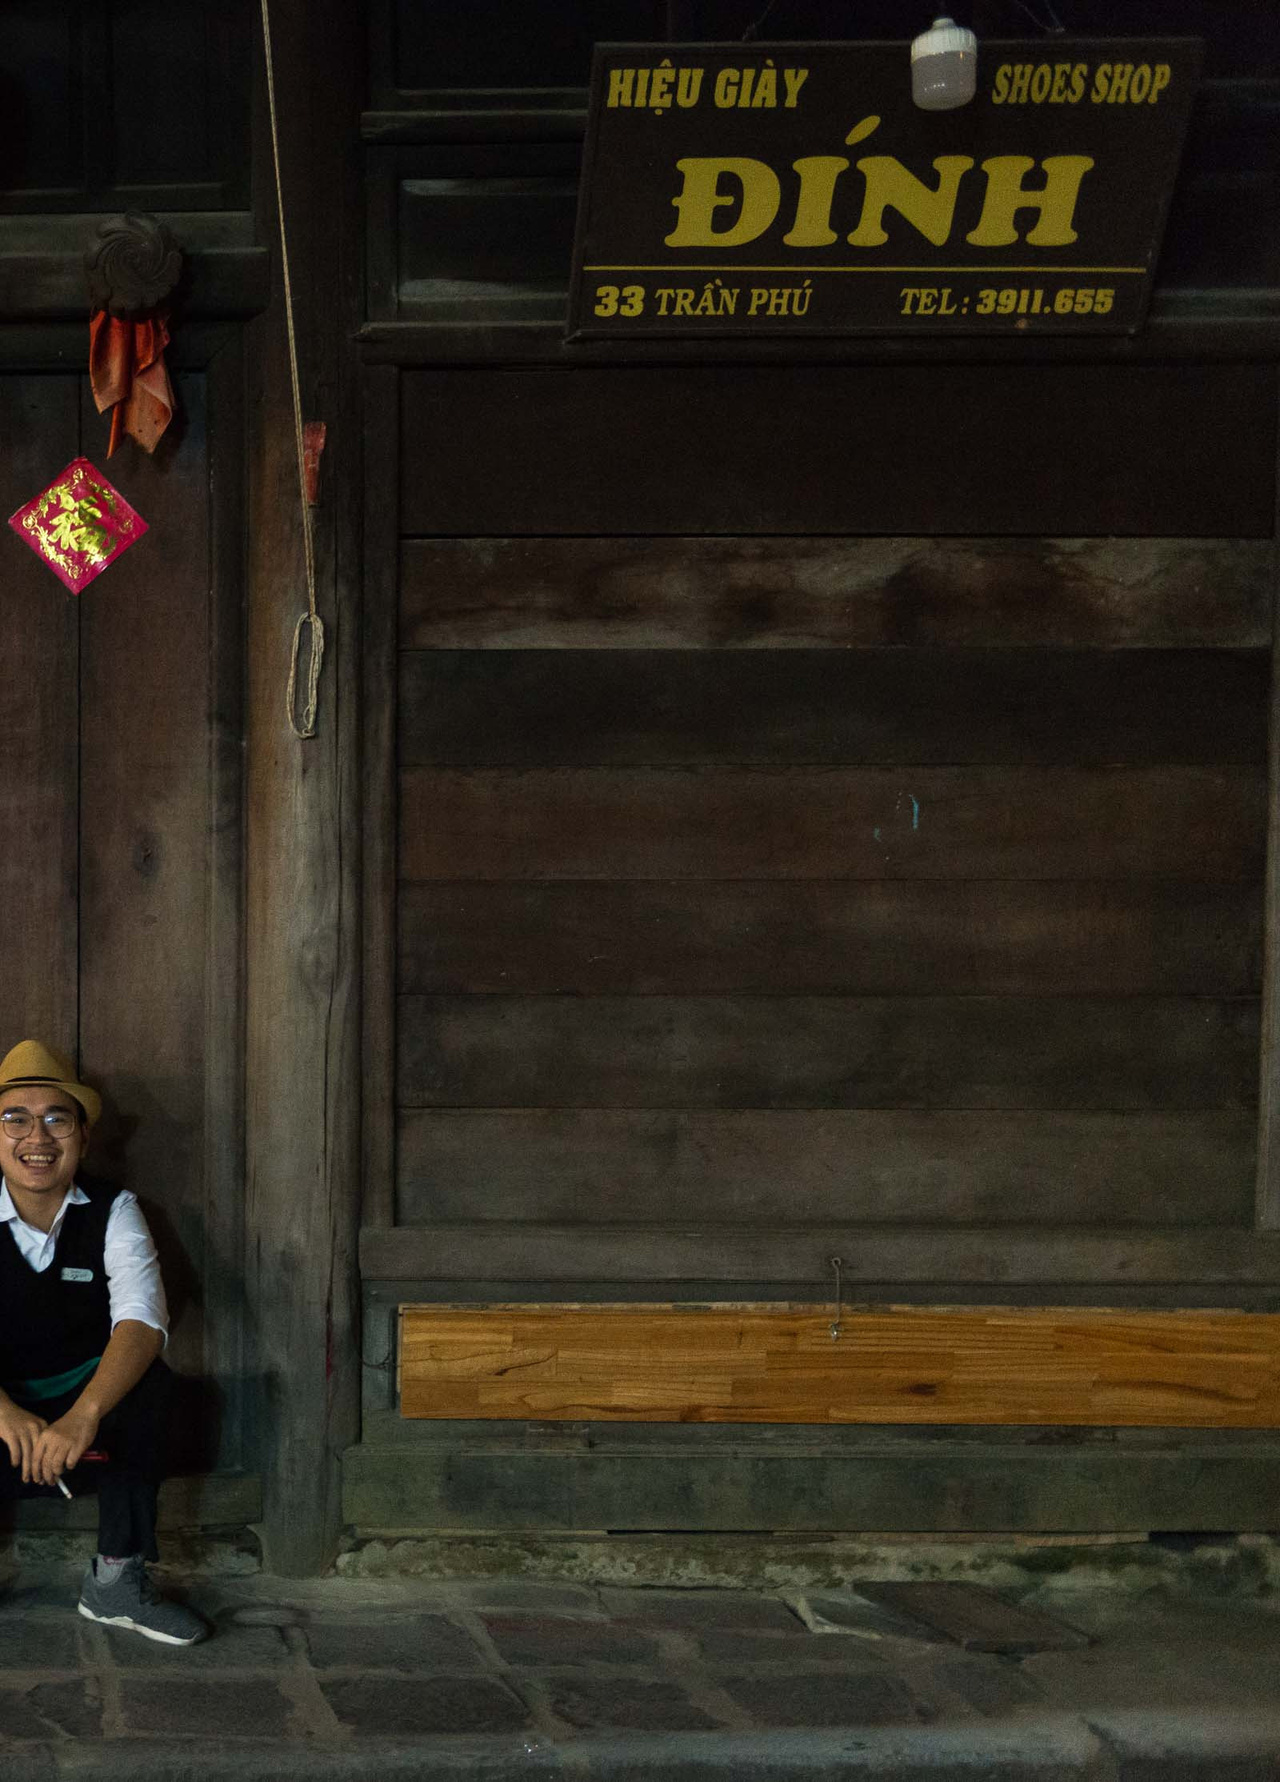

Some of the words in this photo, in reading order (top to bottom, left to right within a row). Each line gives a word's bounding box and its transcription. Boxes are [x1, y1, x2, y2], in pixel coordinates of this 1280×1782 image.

[607, 58, 704, 116] HIỆU
[714, 58, 810, 109] GIÀY
[991, 63, 1088, 105] SHOES
[1090, 63, 1171, 104] SHOP
[664, 115, 1095, 248] ĐÍNH
[594, 285, 645, 317] 33
[654, 278, 740, 316] TRẦN
[747, 279, 813, 316] PHÚ
[975, 288, 1115, 315] 3911.655
